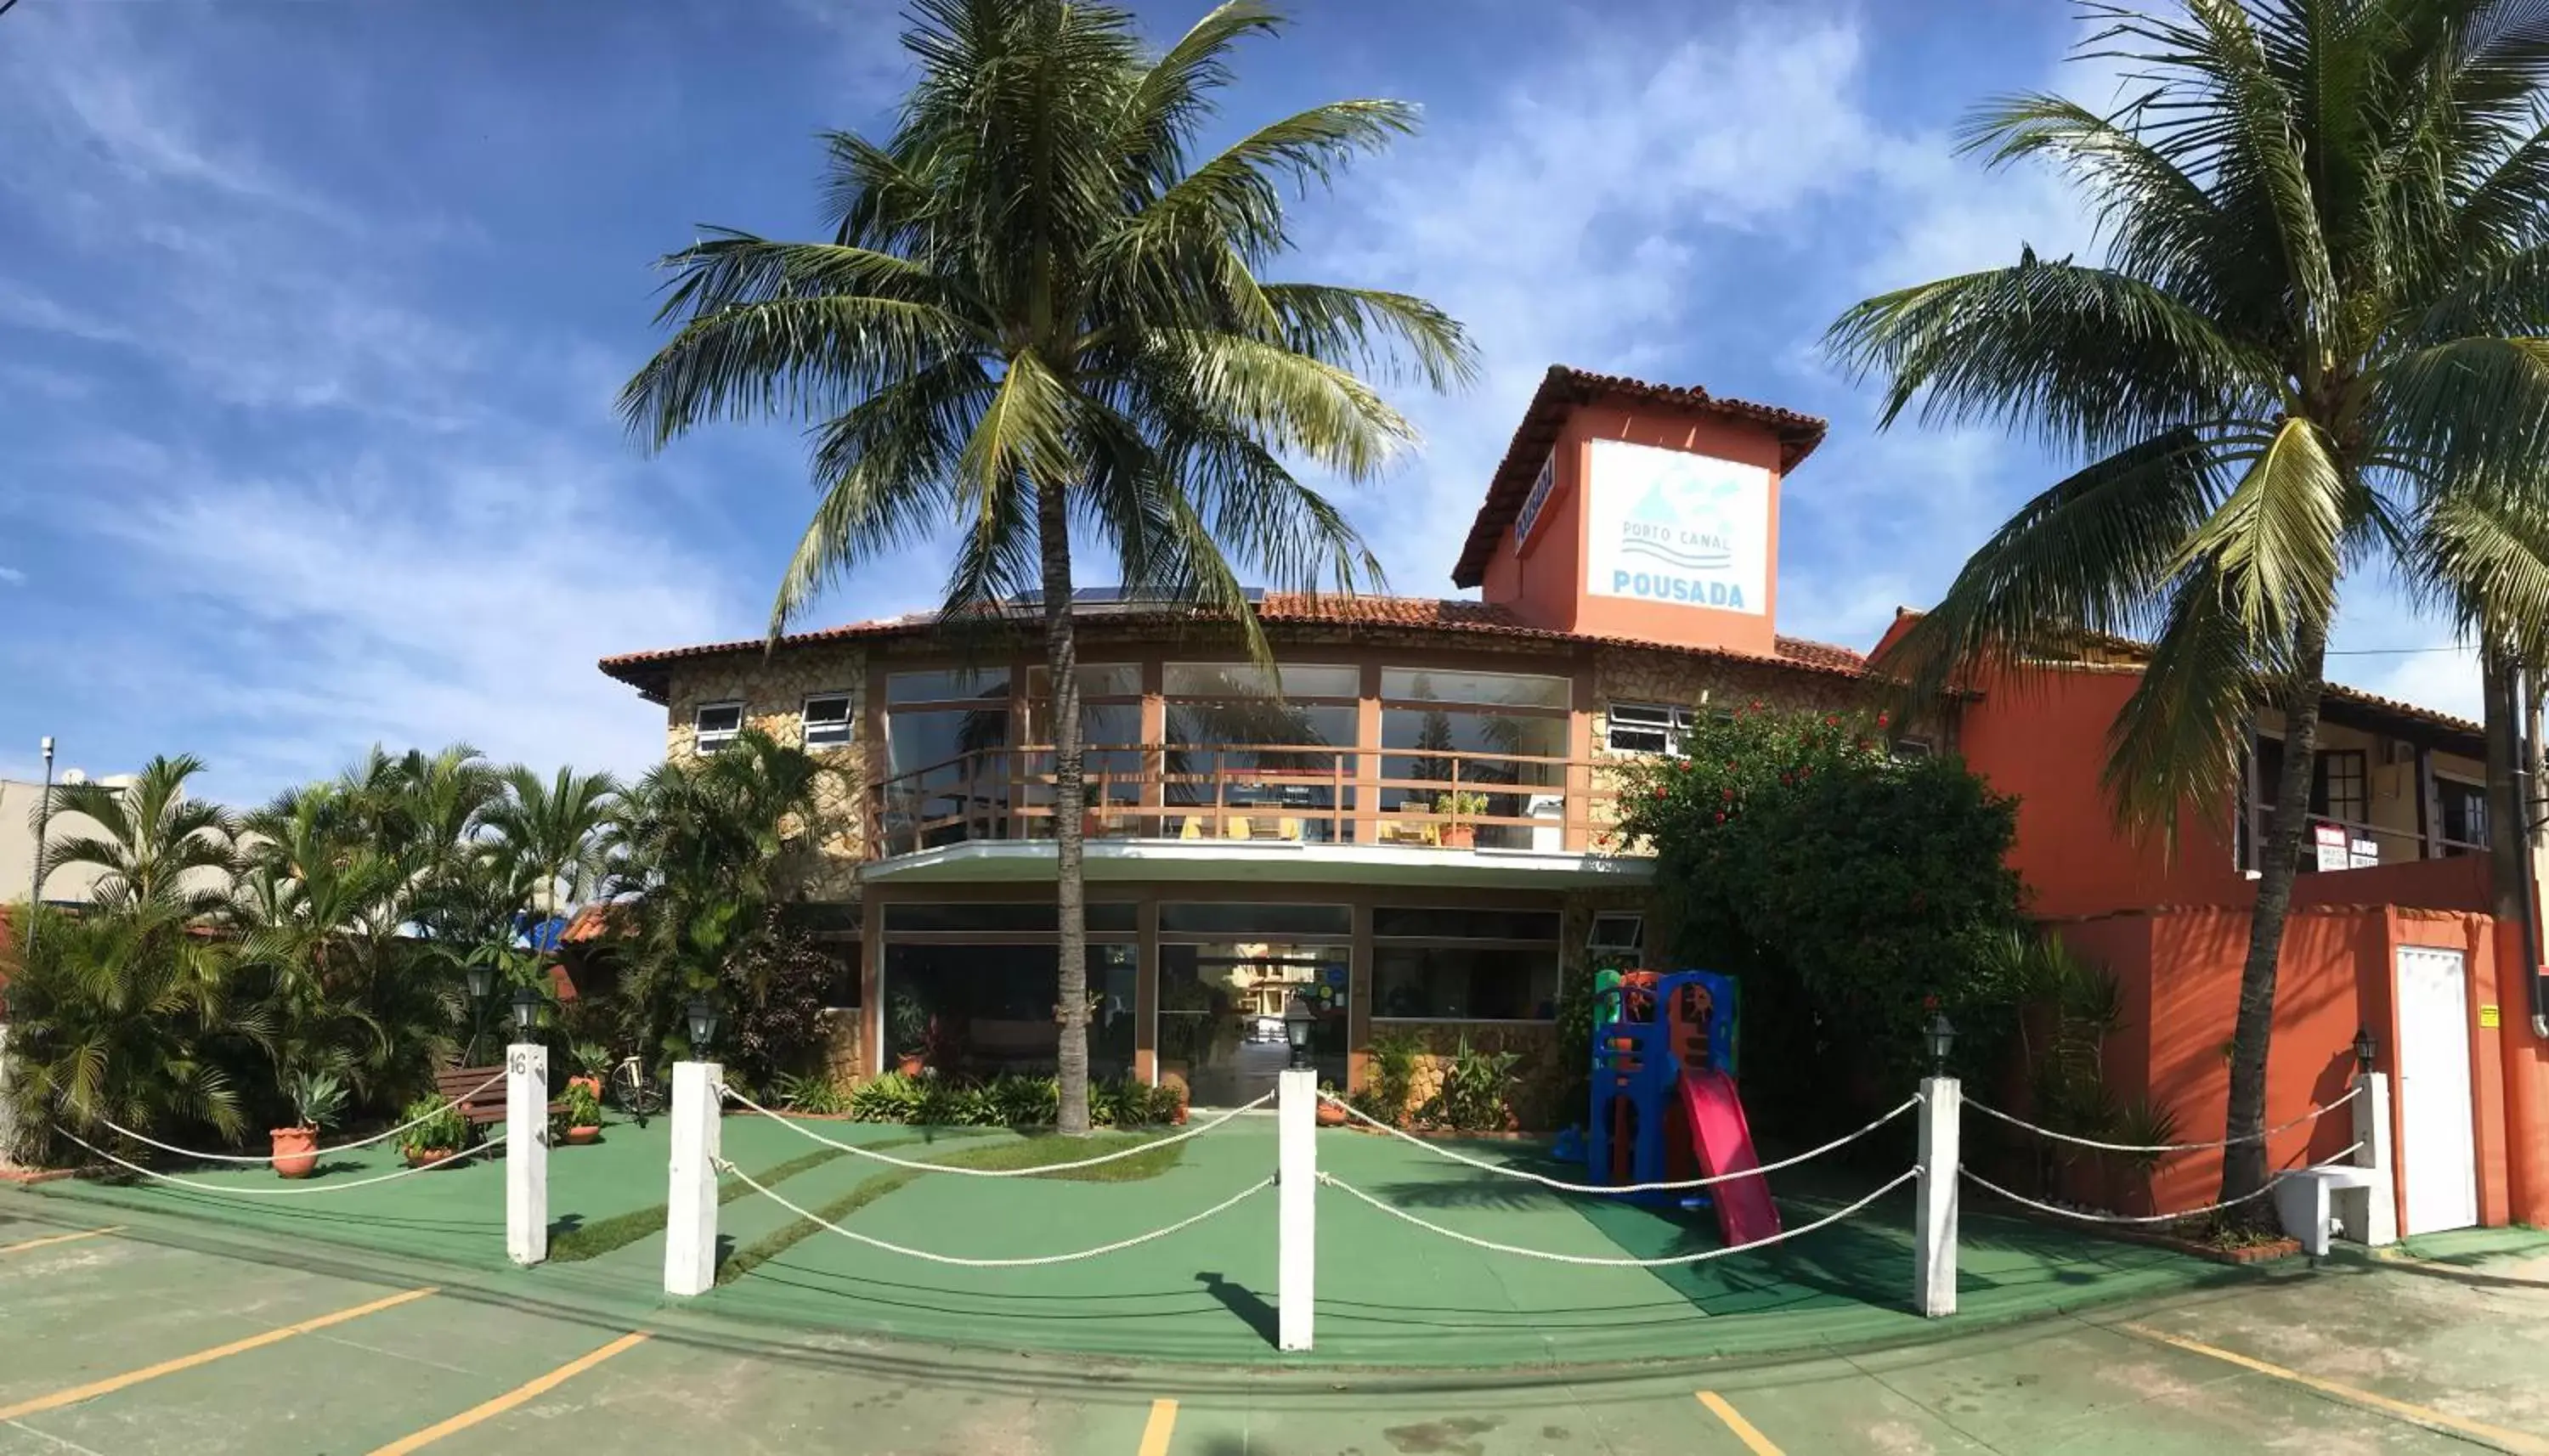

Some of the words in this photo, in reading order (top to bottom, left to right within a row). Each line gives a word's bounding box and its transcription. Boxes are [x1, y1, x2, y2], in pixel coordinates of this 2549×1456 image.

[1623, 521, 1671, 542] PORTO
[1680, 531, 1732, 551] CANAL
[1614, 569, 1745, 609] POUSADA
[511, 1052, 526, 1075] 16
